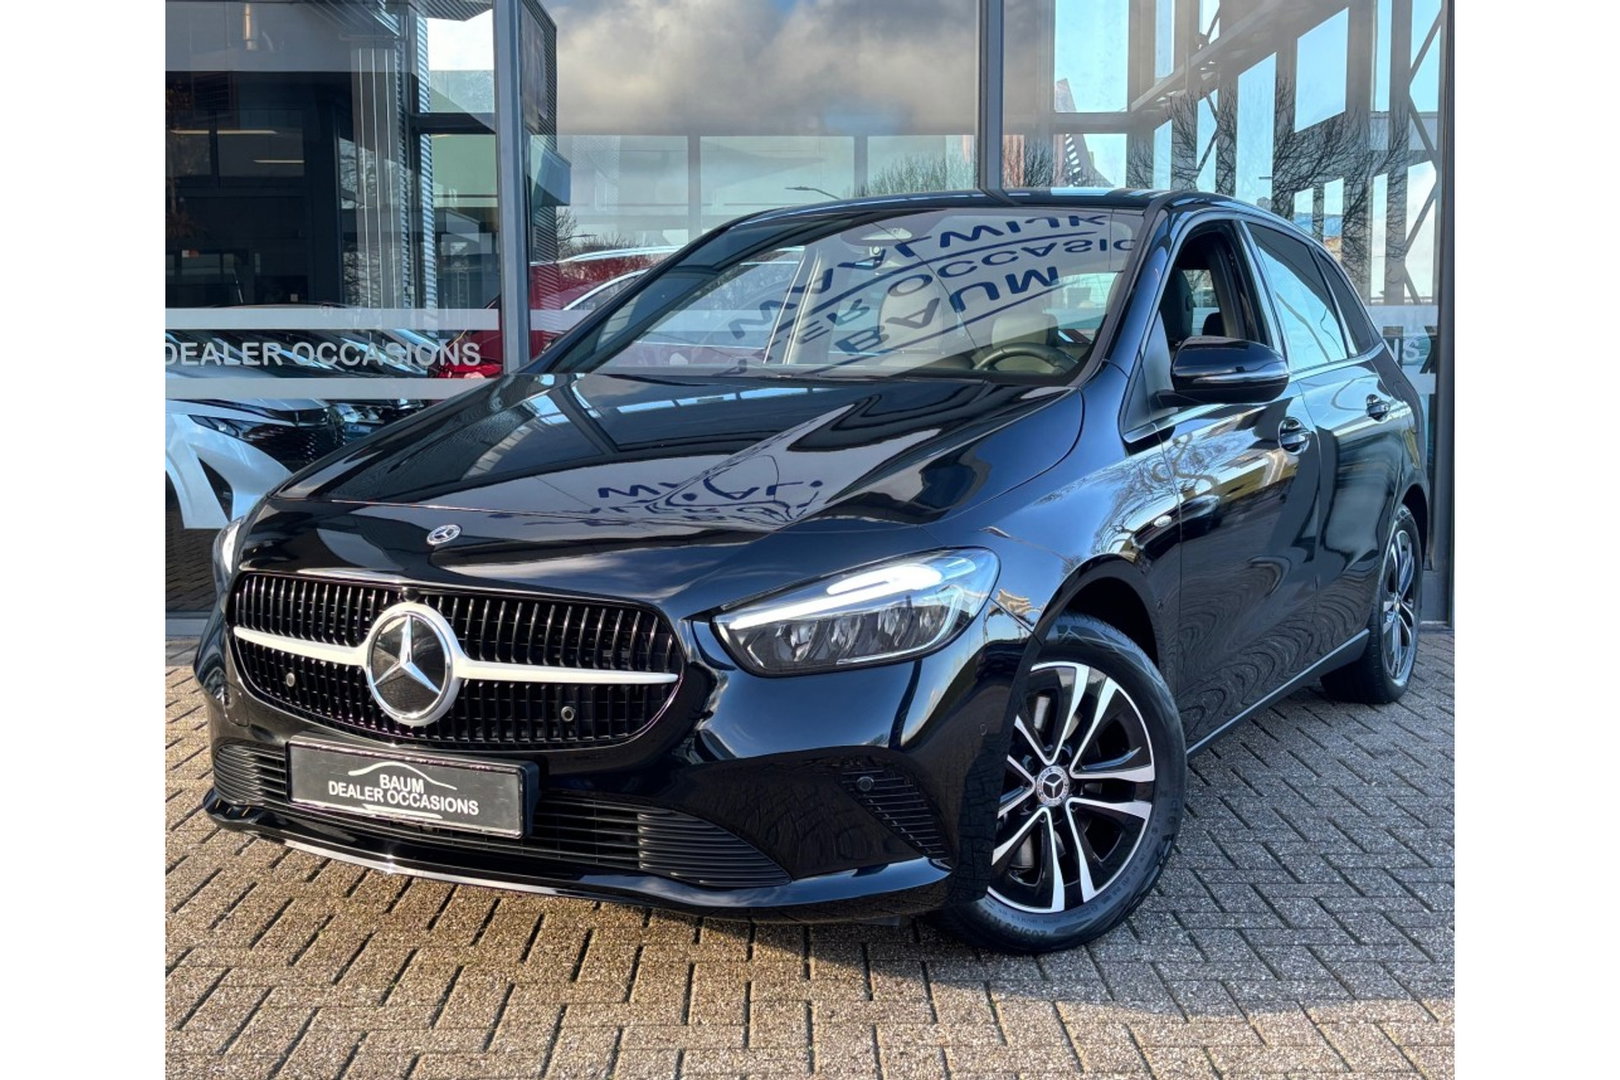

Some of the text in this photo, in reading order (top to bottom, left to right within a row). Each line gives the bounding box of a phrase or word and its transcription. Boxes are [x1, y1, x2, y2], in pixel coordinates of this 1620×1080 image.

[292, 341, 482, 367] OCCASIONS
[379, 774, 425, 794] BAUM
[328, 780, 480, 816] DEALER OCCASIONS
